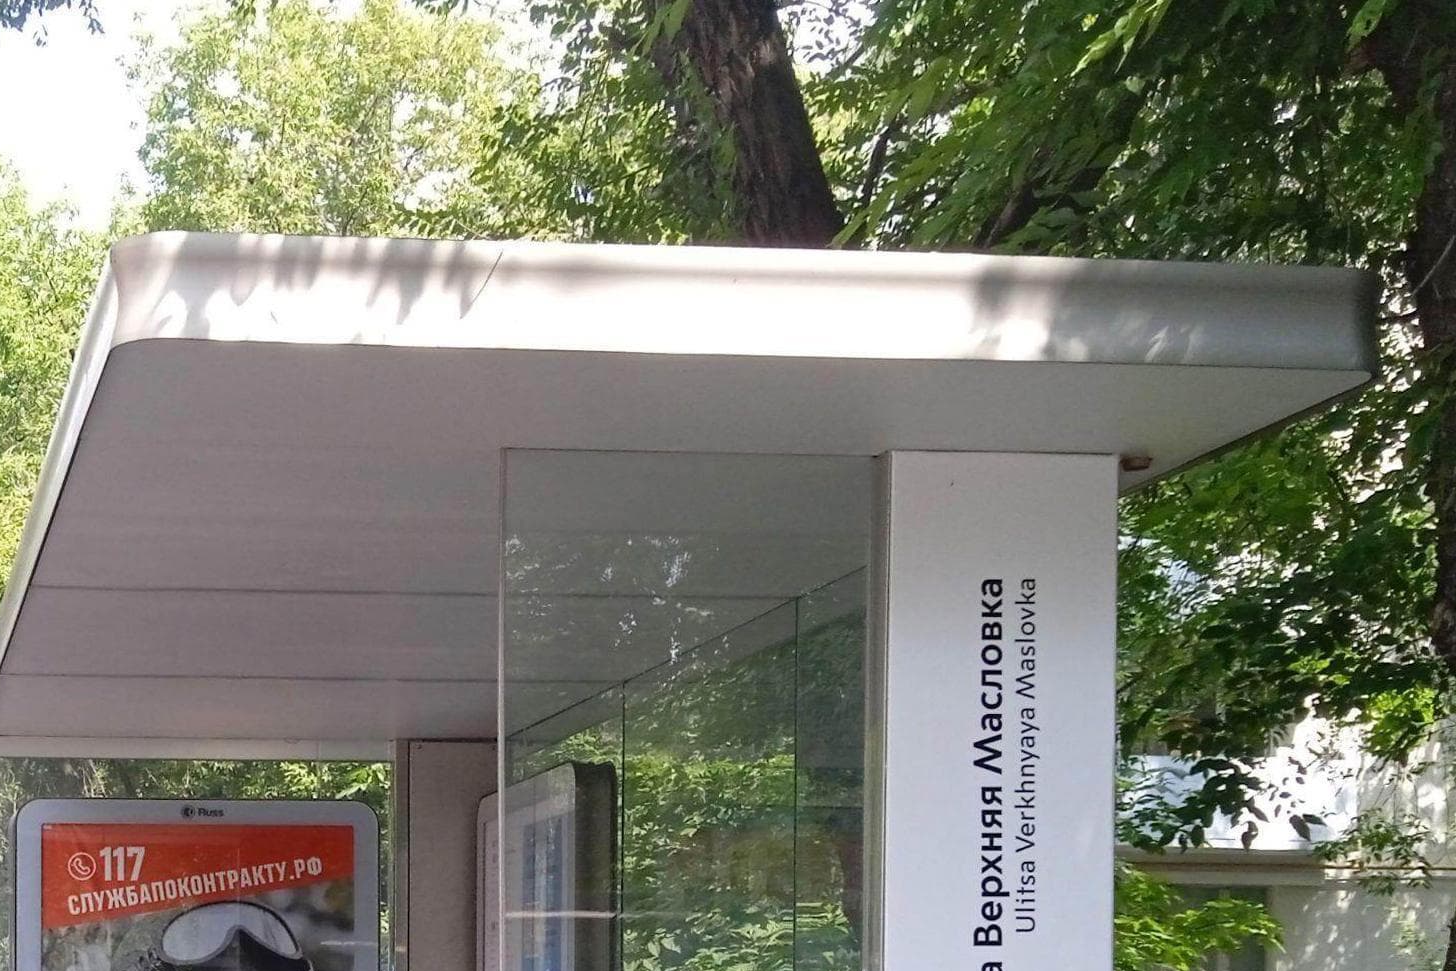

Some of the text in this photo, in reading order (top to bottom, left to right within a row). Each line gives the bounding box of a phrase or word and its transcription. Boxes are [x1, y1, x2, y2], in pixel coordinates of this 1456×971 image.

[973, 577, 1004, 775] Масловка
[1014, 577, 1041, 933] Ulitsa Verkhnyaya Maslovka
[67, 856, 323, 916] СЛУЖБАПОКОНТРАКТУ.РФ
[99, 846, 146, 882] 117
[973, 786, 1010, 948] Верхняя
